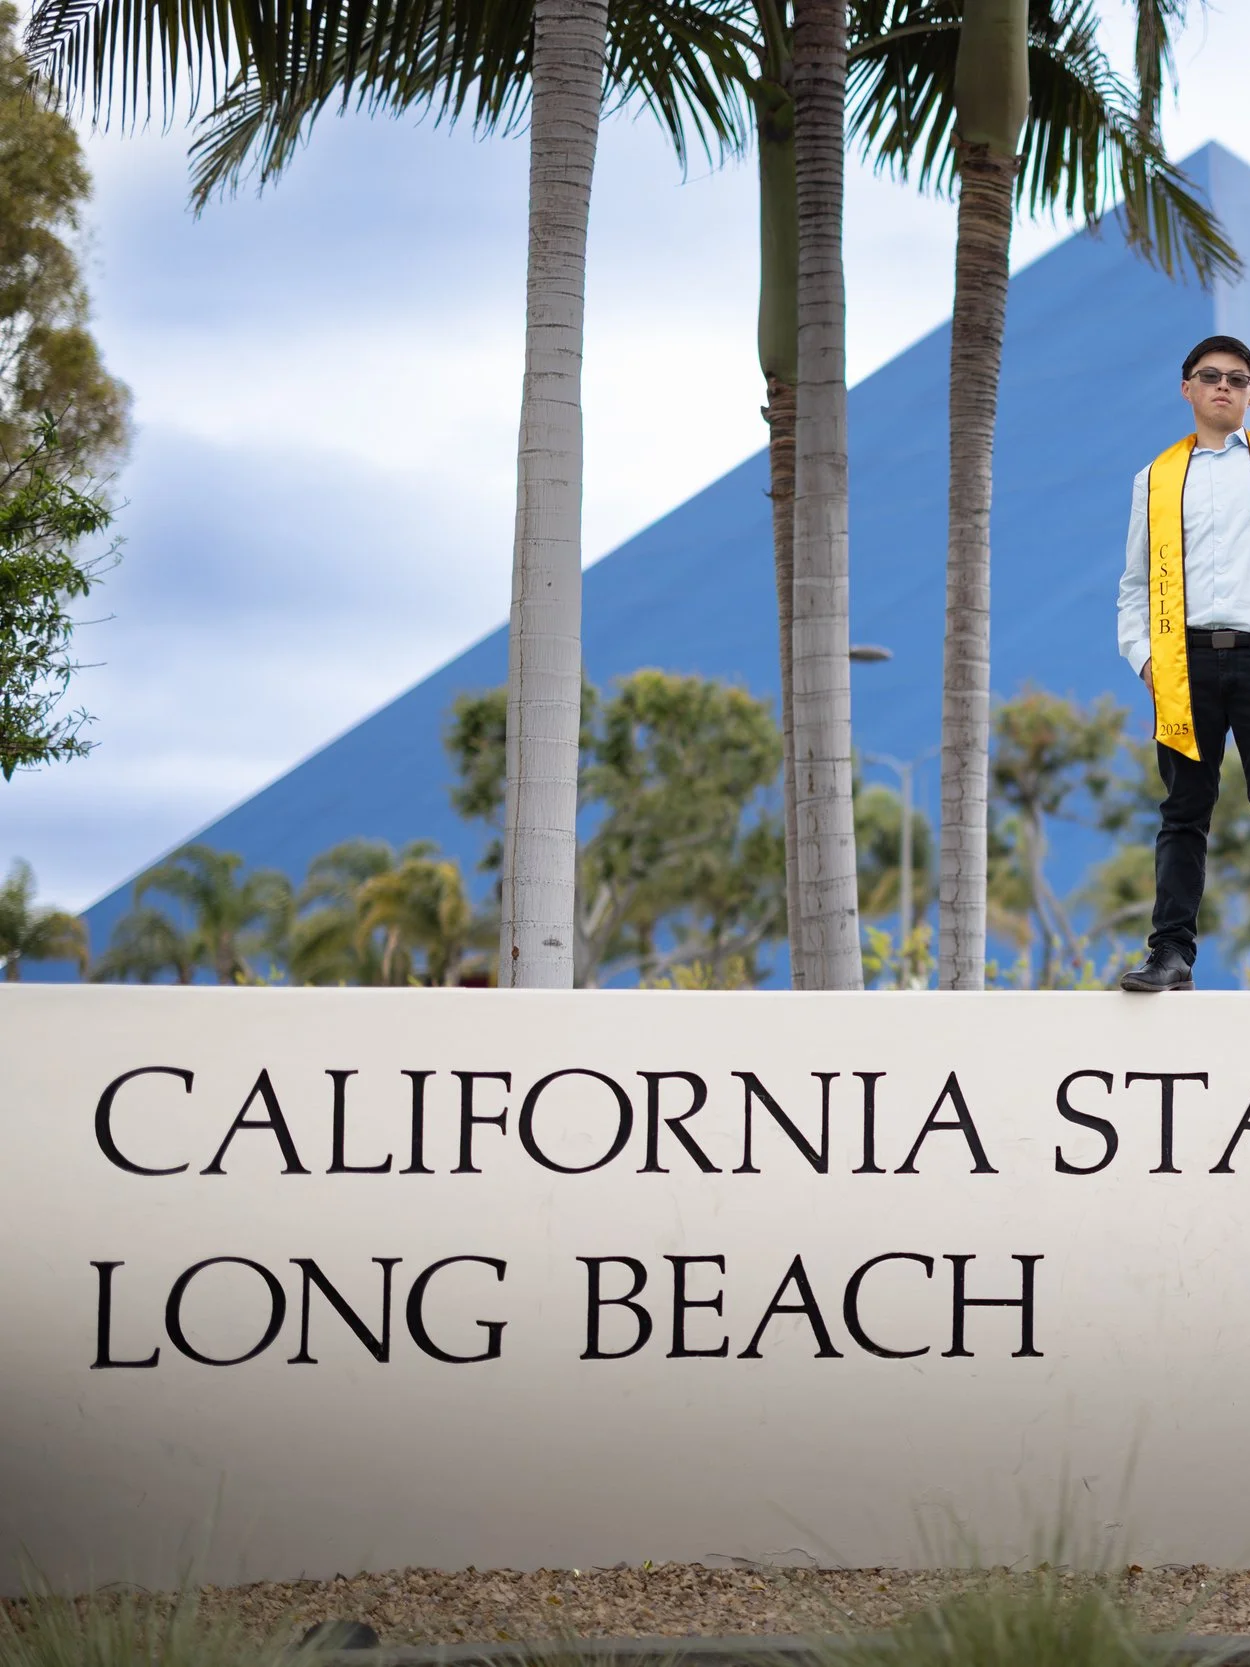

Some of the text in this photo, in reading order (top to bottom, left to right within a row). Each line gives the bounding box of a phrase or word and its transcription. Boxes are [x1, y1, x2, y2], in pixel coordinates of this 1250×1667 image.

[1159, 544, 1171, 634] CSULB
[1160, 723, 1189, 736] 2025
[95, 1067, 999, 1176] CALIFORNIA
[90, 1253, 1044, 1369] LONG BEACH
